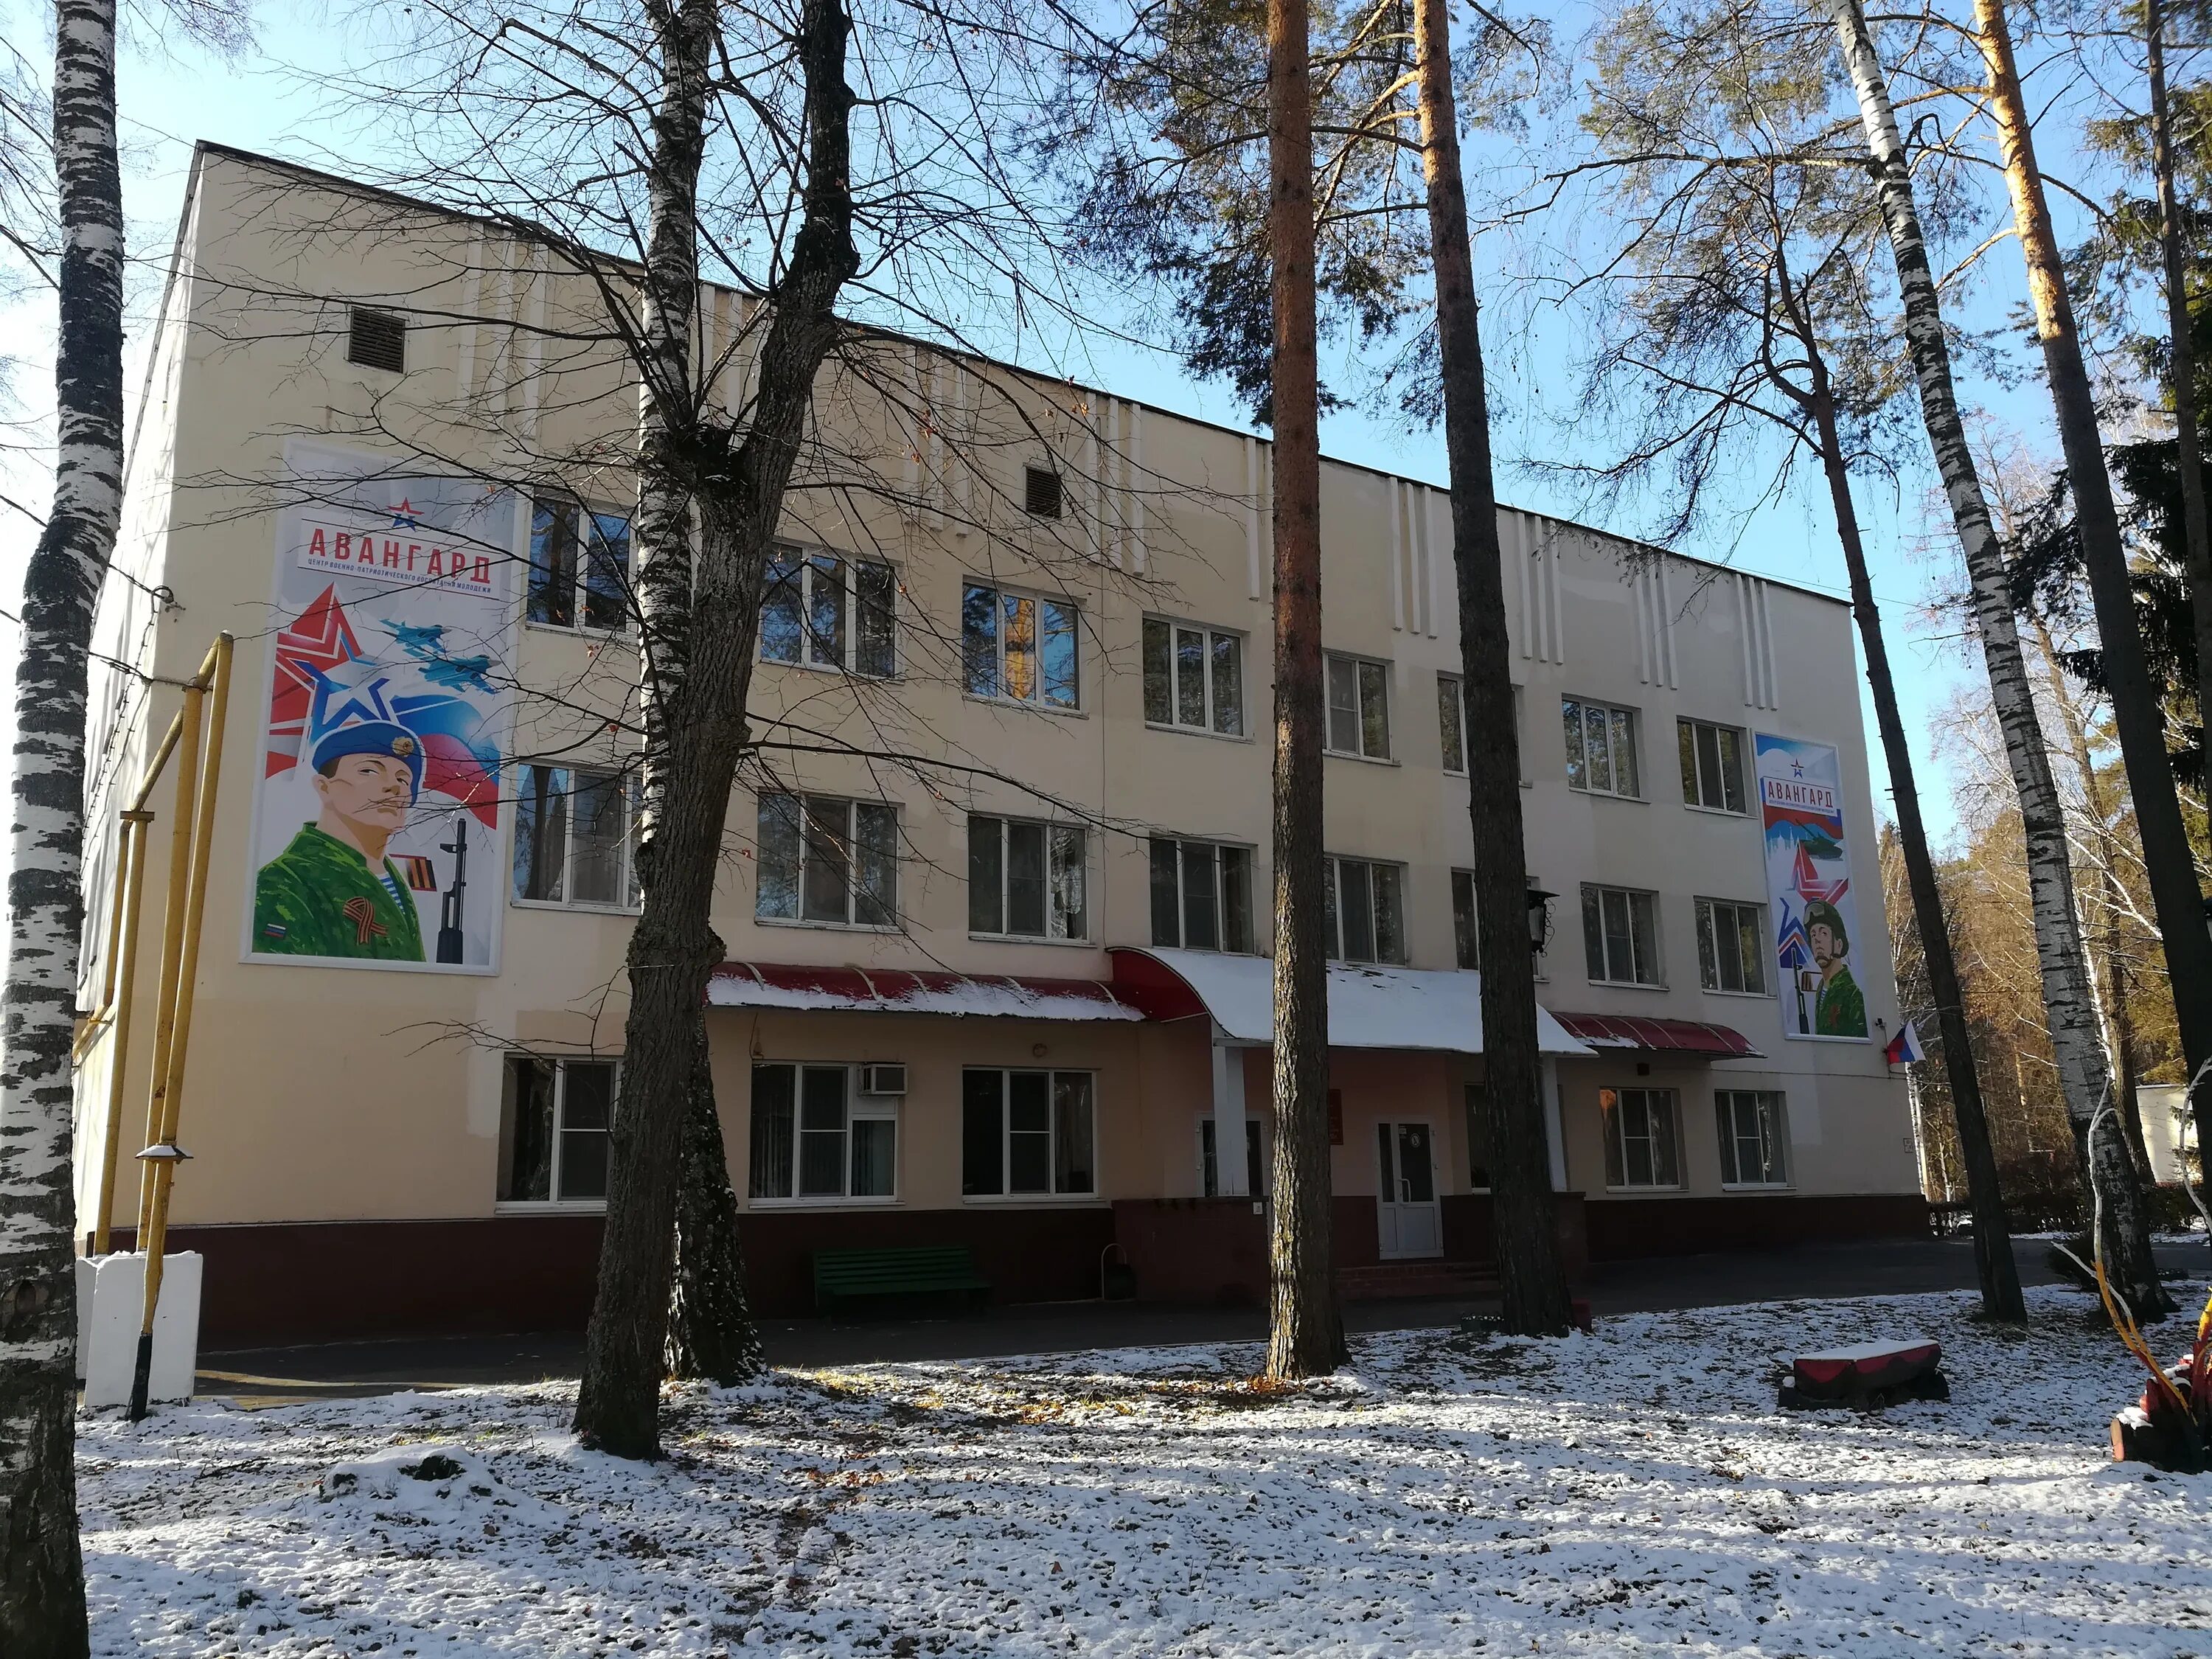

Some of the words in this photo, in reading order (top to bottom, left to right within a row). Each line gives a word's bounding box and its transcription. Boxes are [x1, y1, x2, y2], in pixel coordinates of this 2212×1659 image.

[308, 558, 328, 567] ЦЕНТР
[309, 529, 491, 584] АВАНГАРД
[1769, 781, 1833, 807] АВАНГАРД
